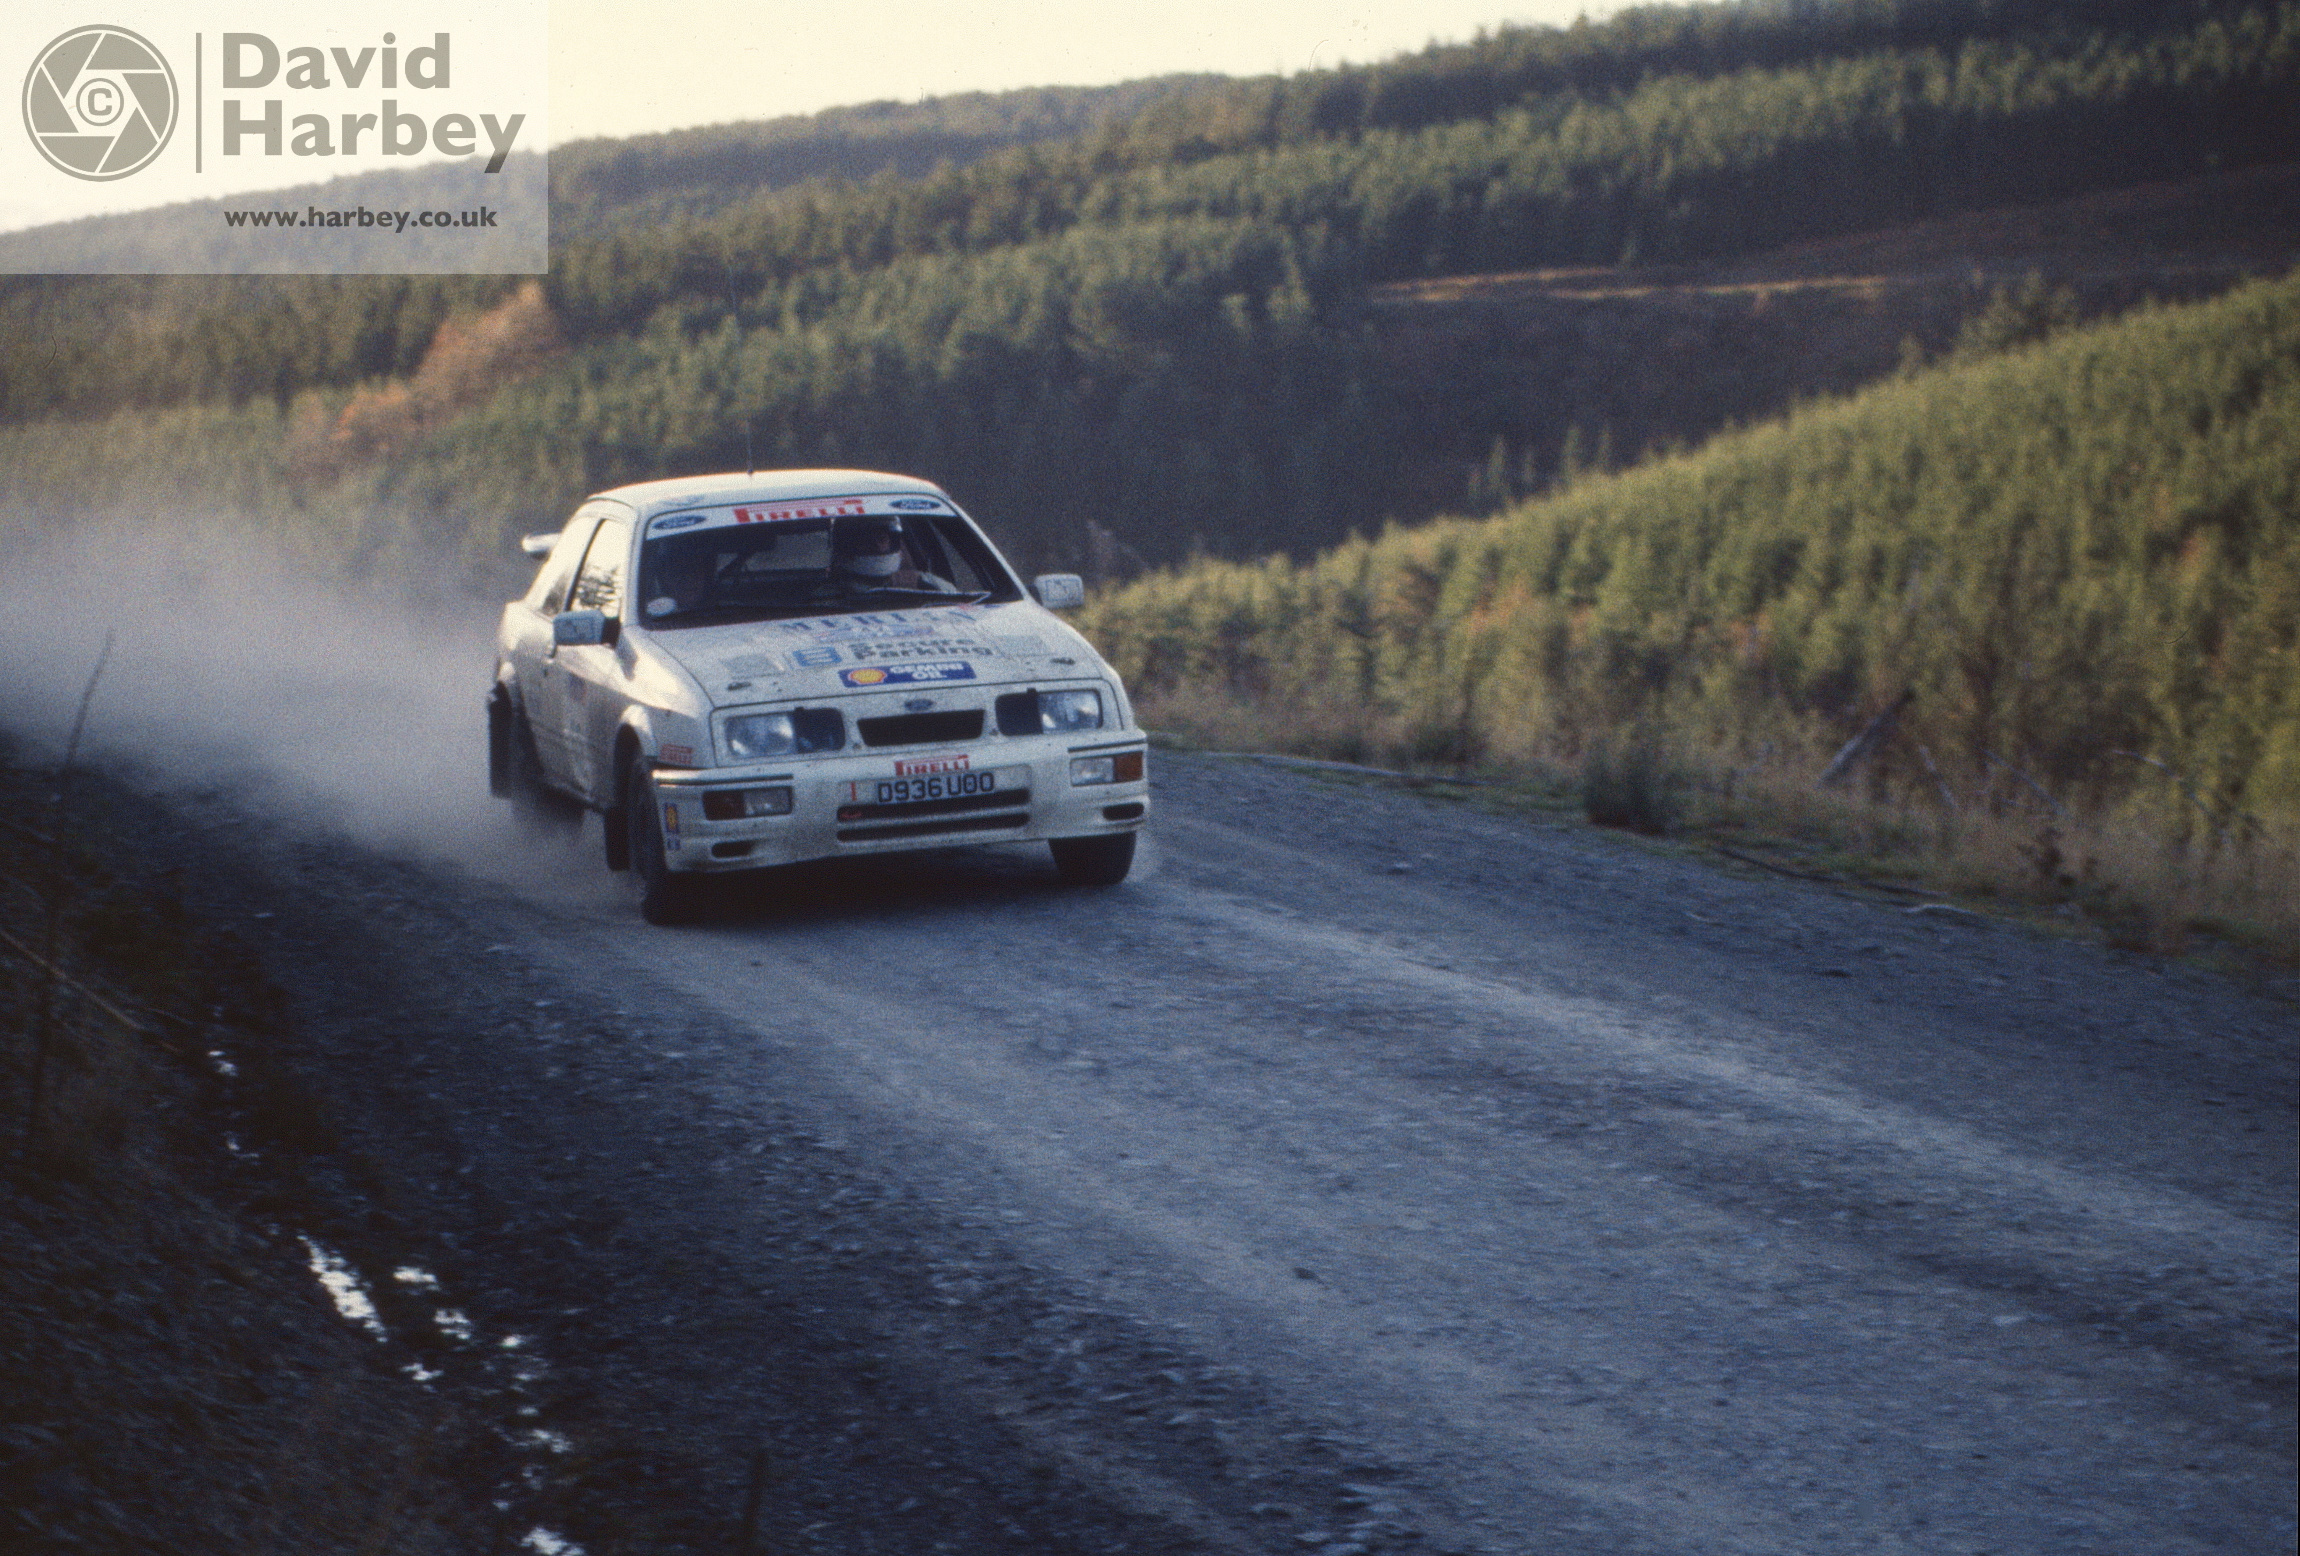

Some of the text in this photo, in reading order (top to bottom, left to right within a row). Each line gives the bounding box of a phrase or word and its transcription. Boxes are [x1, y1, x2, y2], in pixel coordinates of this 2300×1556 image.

[733, 498, 866, 524] PIRELLI
[852, 646, 993, 660] Parking
[911, 670, 947, 680] OIL
[894, 754, 969, 776] PIRELLI
